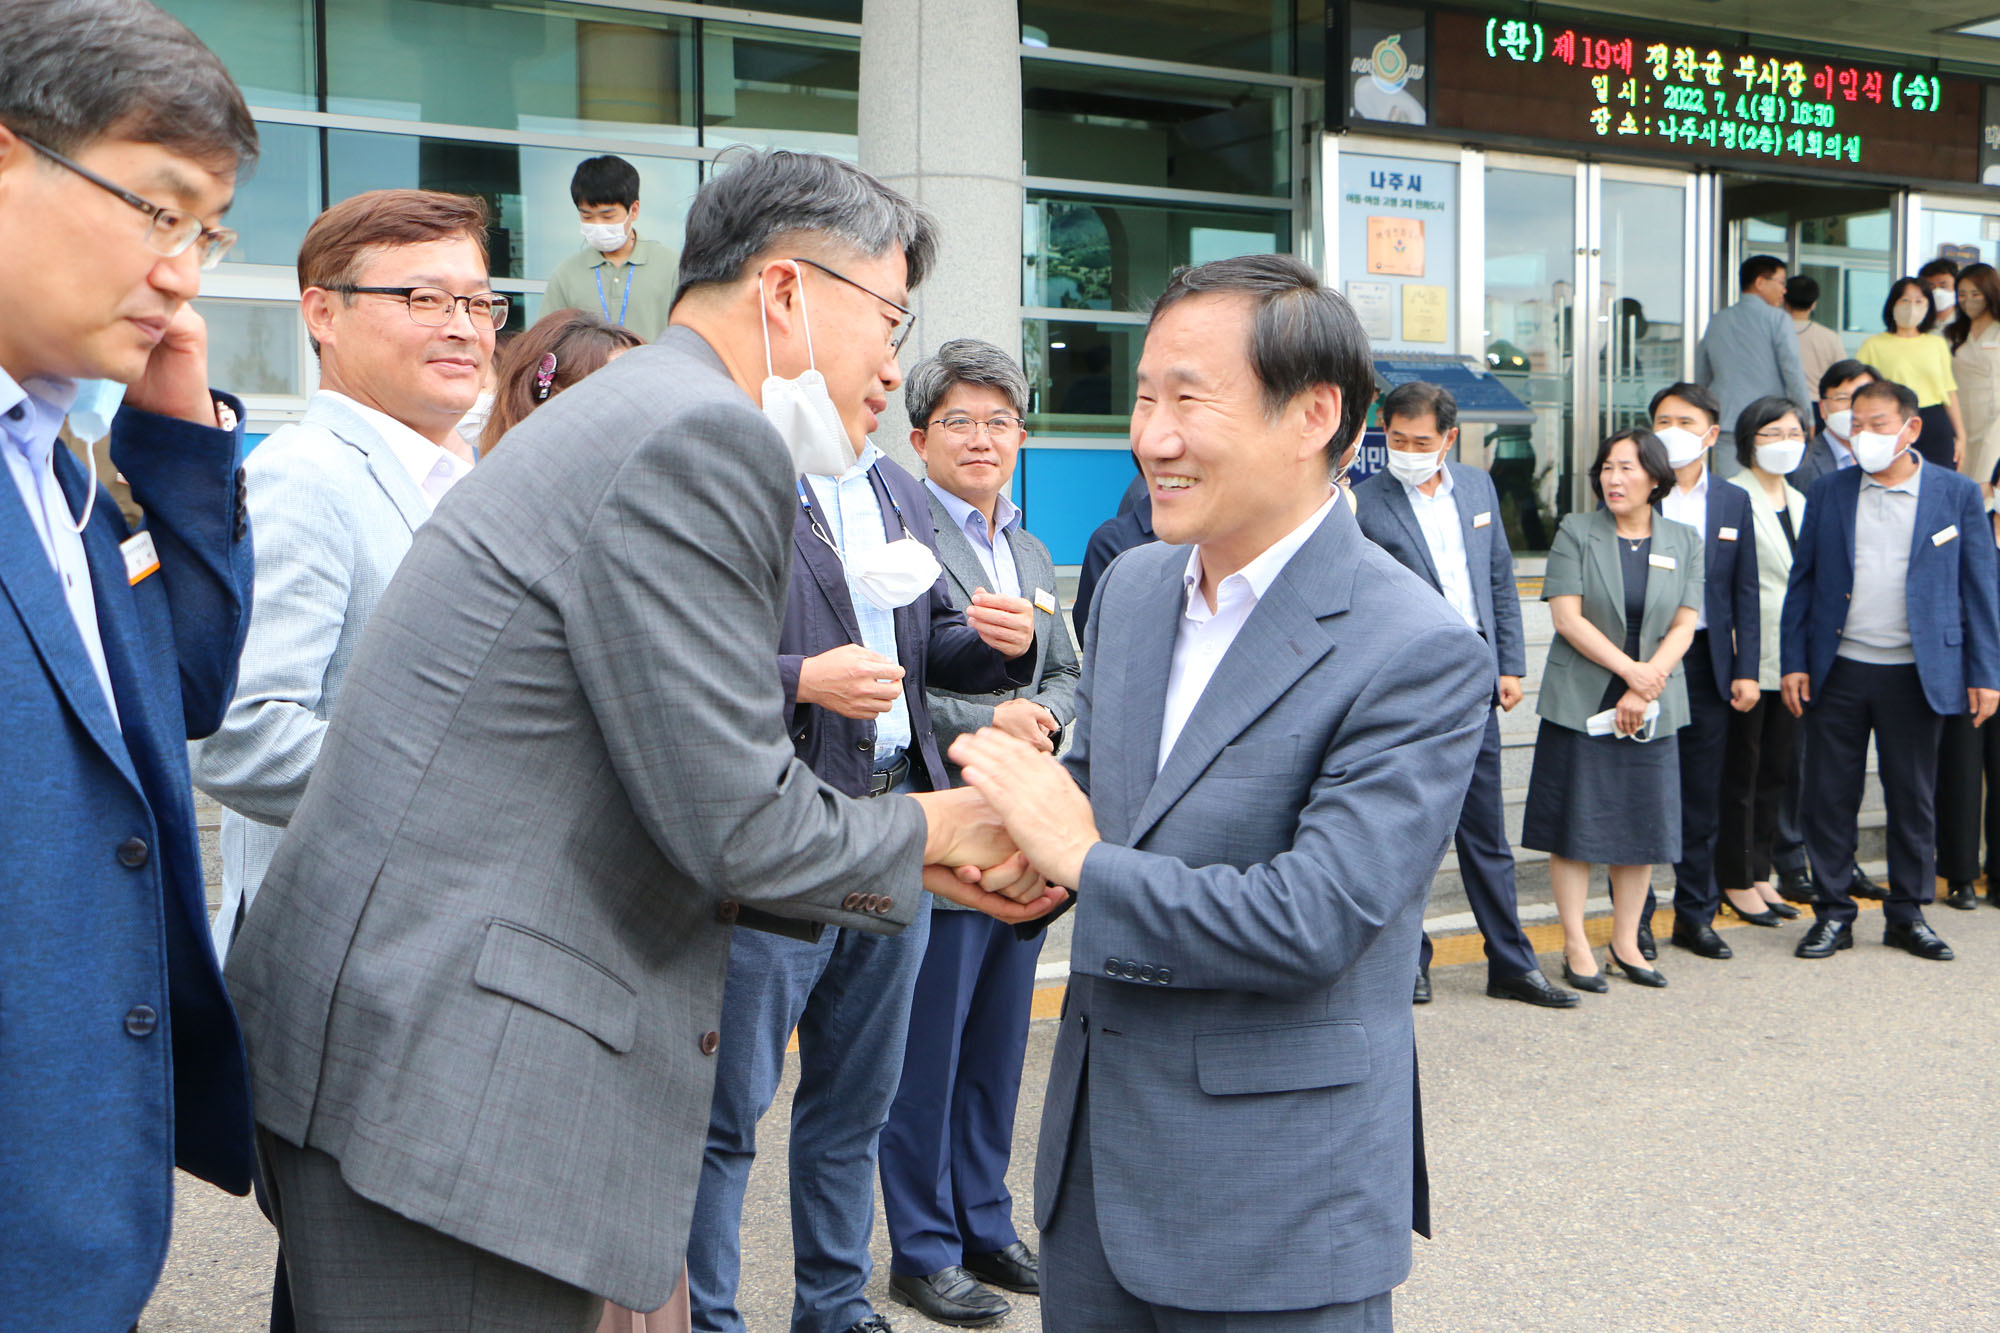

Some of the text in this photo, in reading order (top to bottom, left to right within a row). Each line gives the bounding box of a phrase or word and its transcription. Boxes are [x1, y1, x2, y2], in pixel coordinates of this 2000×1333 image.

[1485, 17, 1941, 112] (환) 제19대 정찬균 부시장 이임식 (송)
[1786, 129, 1861, 163] 대회의실
[1370, 170, 1422, 192] 나주시
